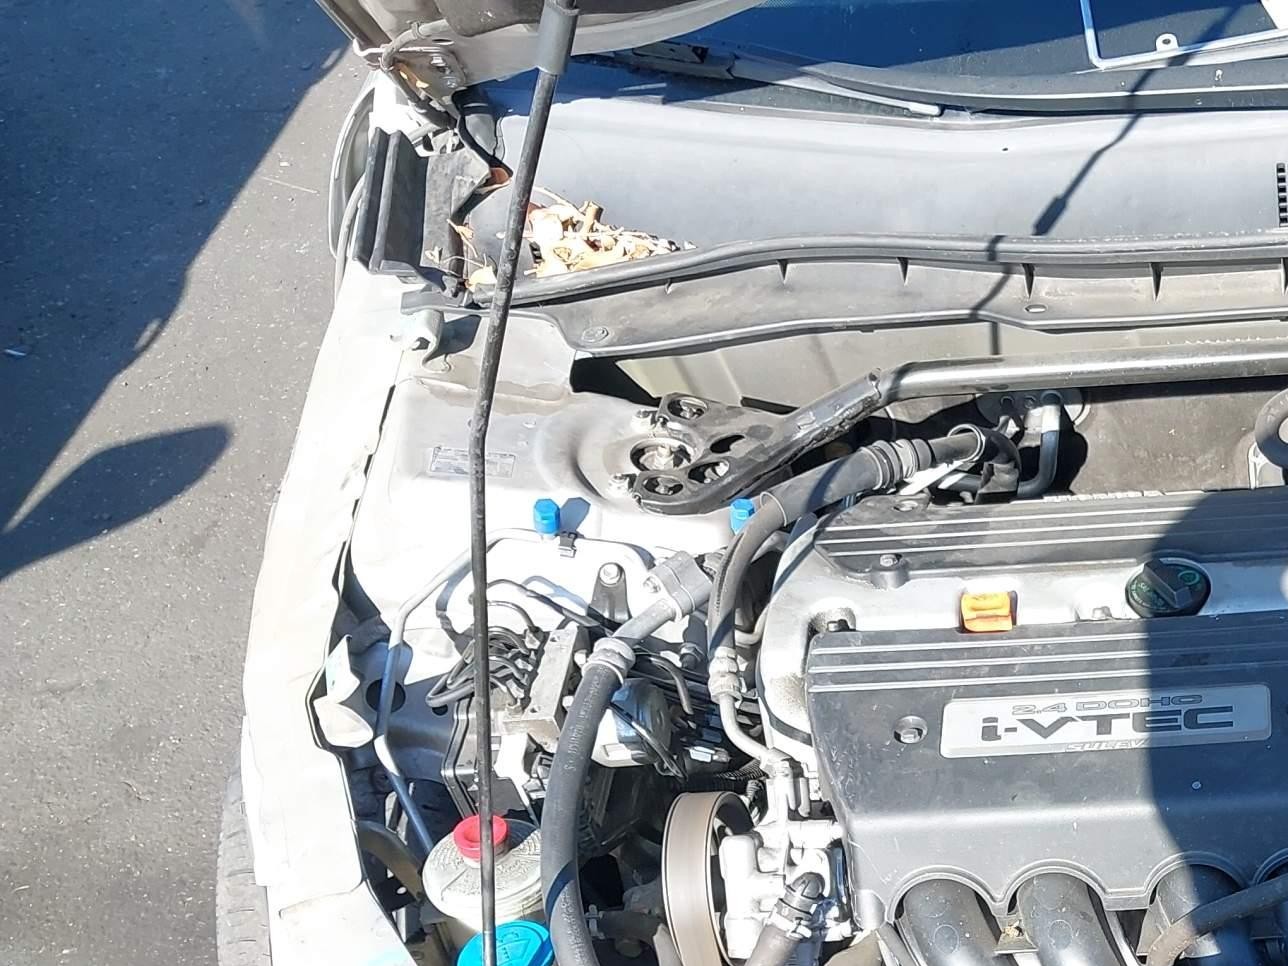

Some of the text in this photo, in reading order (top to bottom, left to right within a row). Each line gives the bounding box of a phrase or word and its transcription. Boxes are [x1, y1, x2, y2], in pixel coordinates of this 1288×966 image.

[1012, 694, 1204, 716] 2.4 DOHC
[980, 705, 1234, 742] i-VTEC
